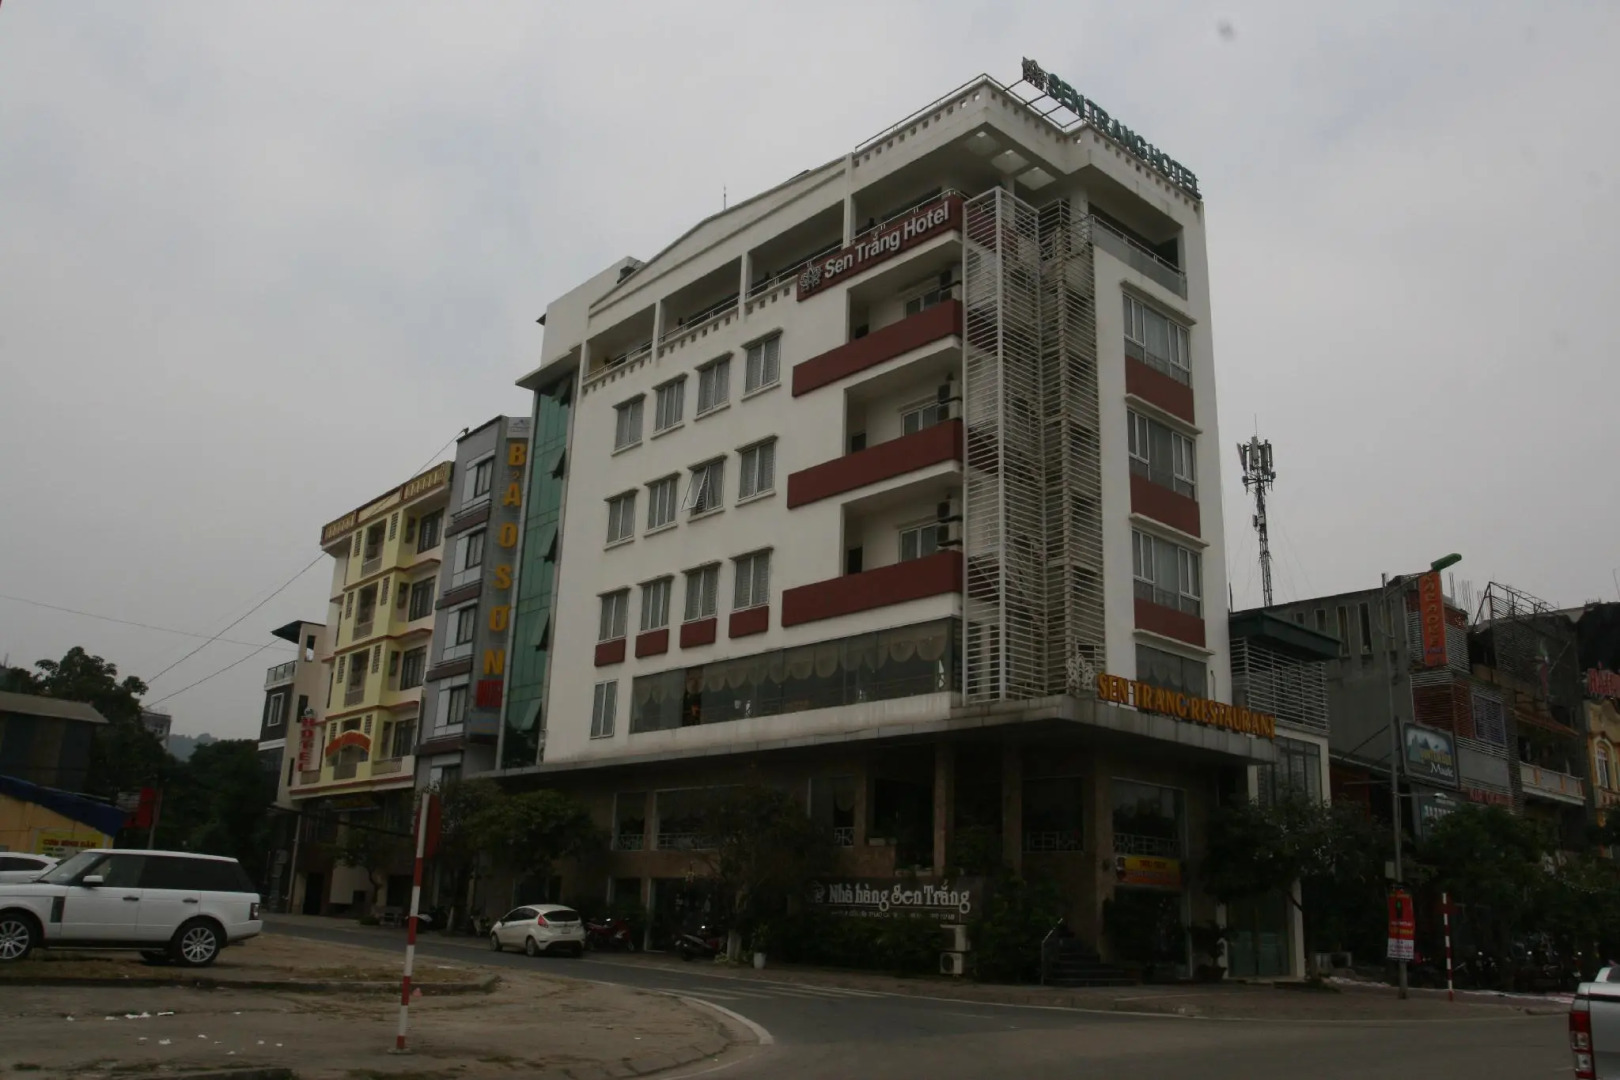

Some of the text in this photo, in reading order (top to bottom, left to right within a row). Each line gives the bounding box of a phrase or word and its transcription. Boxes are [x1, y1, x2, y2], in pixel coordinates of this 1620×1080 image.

[1047, 73, 1202, 199] SEN TRANG HOTEL
[824, 201, 950, 279] Sen Trắng Hotel
[1098, 673, 1129, 704] SEN
[1189, 695, 1276, 740] RESTAURANT
[829, 878, 971, 914] Nhà hàng Sen Trắng
